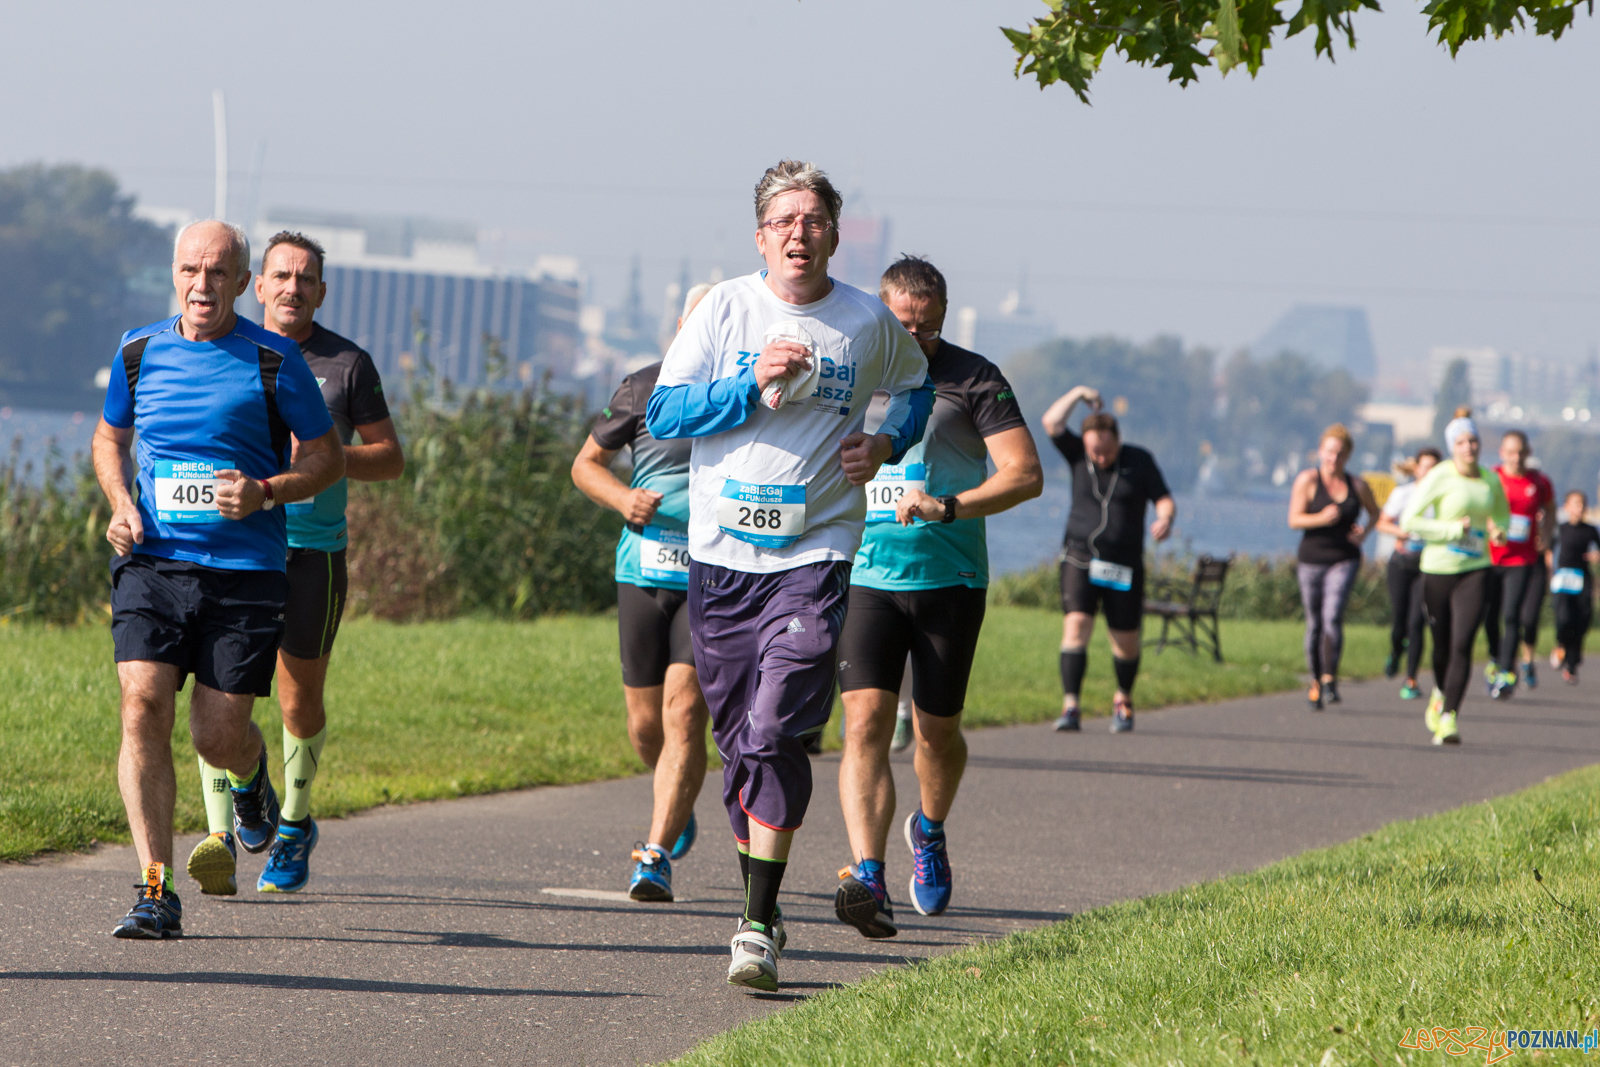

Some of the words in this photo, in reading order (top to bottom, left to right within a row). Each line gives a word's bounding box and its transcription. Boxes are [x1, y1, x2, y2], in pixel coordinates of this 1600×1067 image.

[172, 462, 214, 473] zaBIEGaj
[178, 471, 214, 479] FUNdusze
[172, 485, 214, 504] 405
[739, 485, 783, 497] zaBIEGaj
[745, 493, 783, 503] FUNdusze
[870, 486, 904, 504] 103
[738, 506, 782, 530] 268
[656, 547, 691, 567] 540
